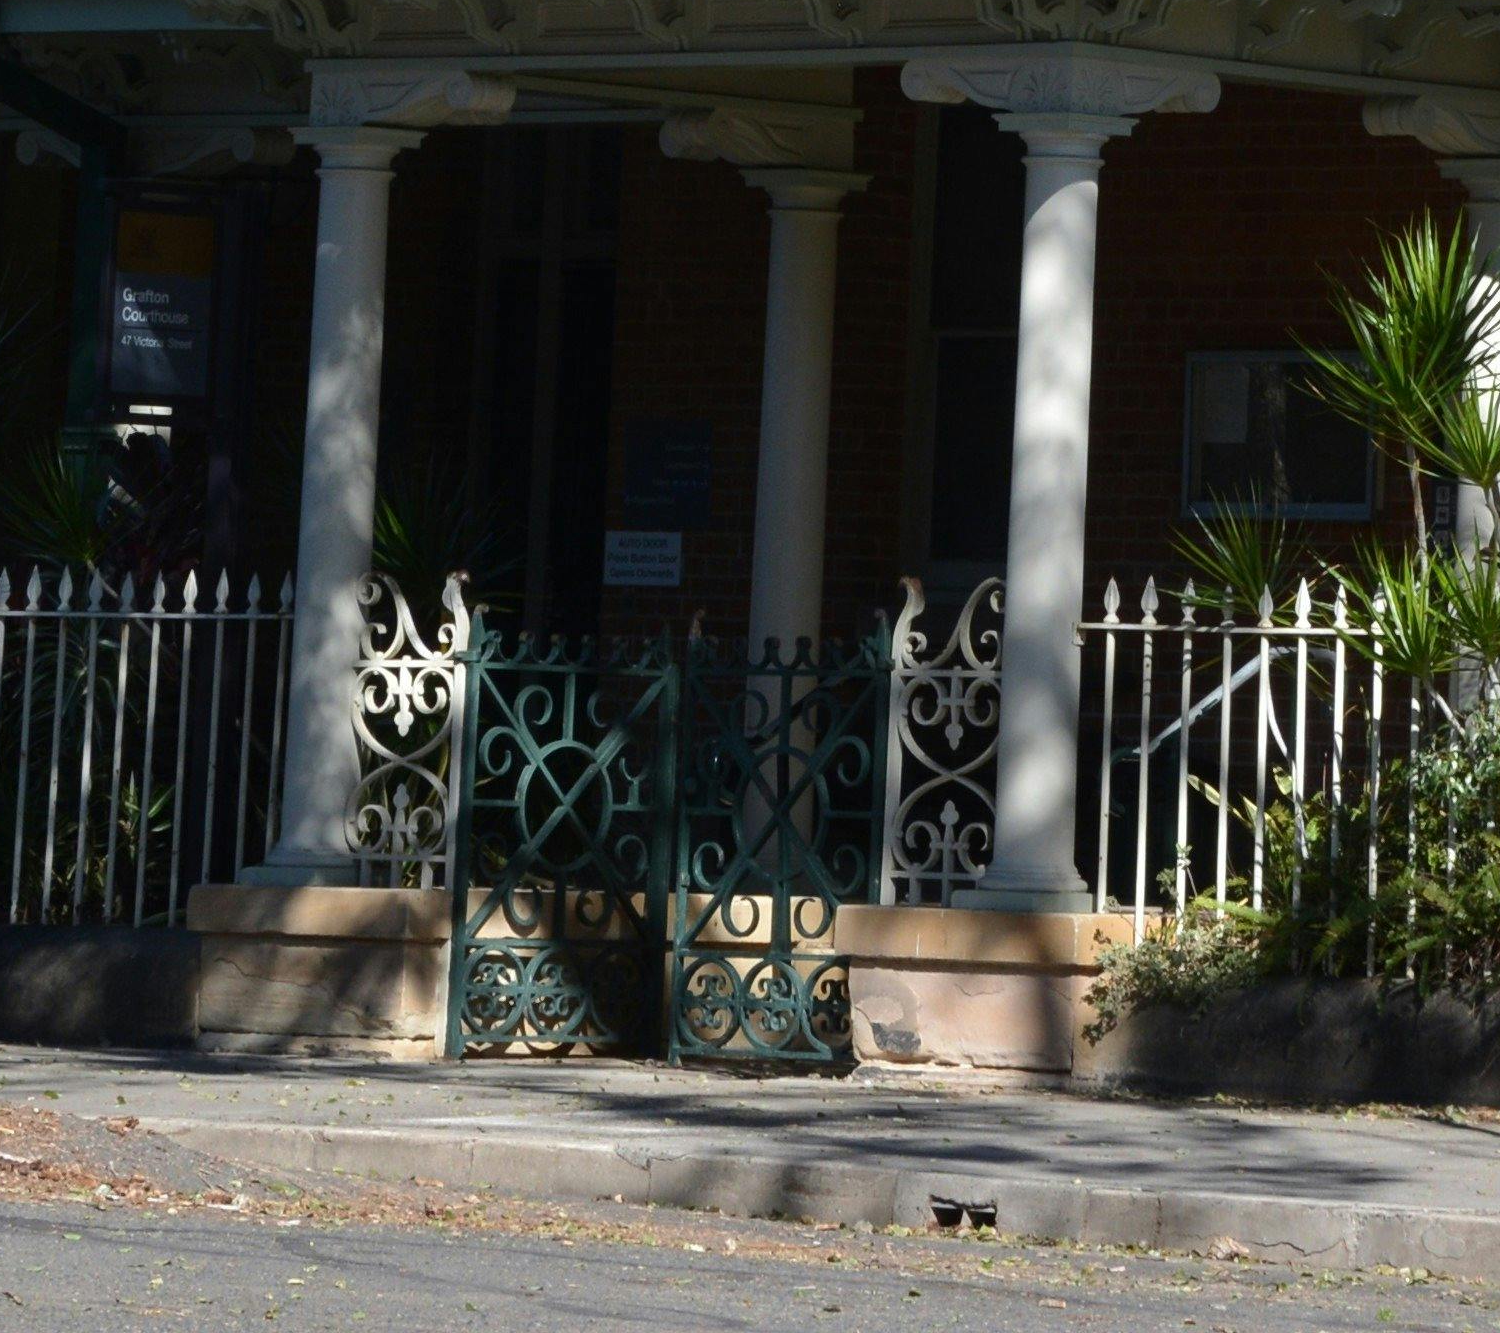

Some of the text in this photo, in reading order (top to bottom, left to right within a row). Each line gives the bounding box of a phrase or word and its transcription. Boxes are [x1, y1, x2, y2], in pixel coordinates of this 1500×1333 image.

[123, 287, 169, 304] Grafton
[122, 306, 190, 325] Courthouse
[121, 335, 192, 350] 47 Victoria Street
